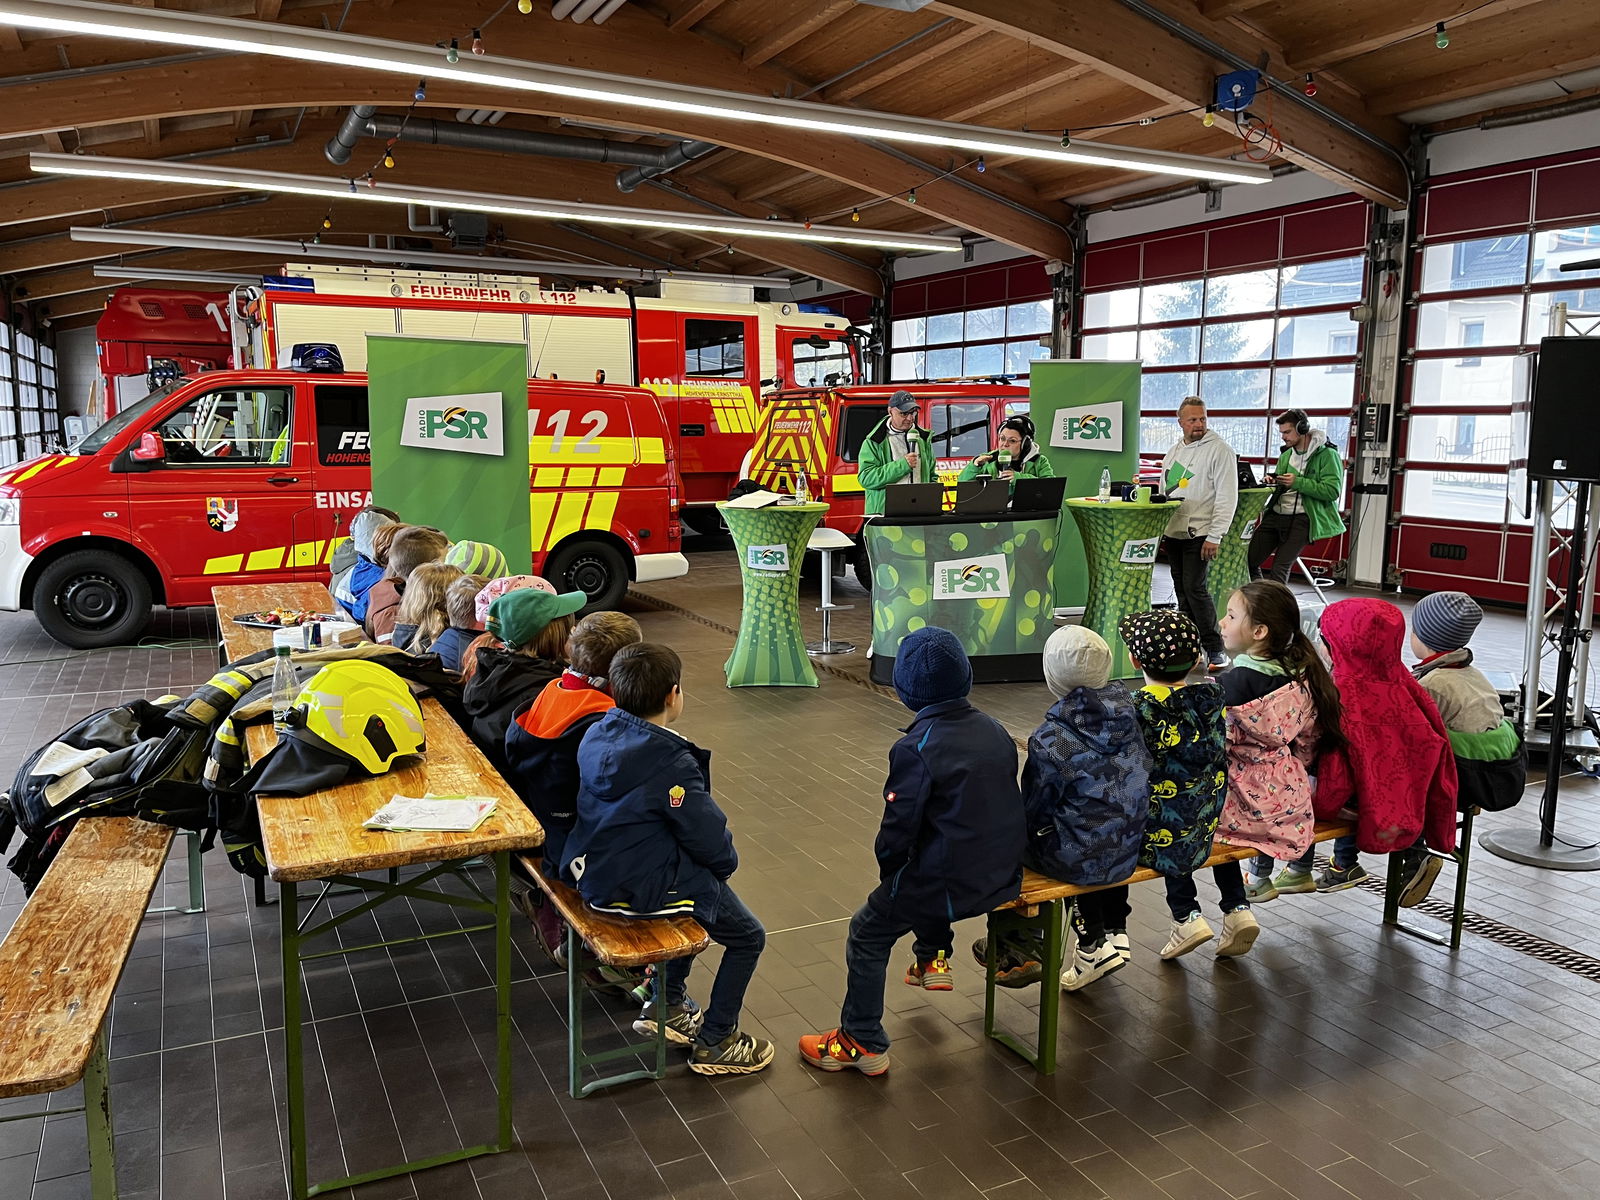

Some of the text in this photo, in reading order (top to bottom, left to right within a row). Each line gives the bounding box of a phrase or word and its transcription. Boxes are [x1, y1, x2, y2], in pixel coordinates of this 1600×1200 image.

[410, 285, 577, 304] FEUERWEHR 112
[680, 380, 741, 391] FEUERWEHR
[418, 406, 488, 439] RADIO PSR
[798, 421, 811, 433] 112
[1068, 414, 1112, 440] PSR
[338, 431, 371, 450] FE
[754, 549, 785, 565] PSR
[1130, 542, 1156, 558] PSR
[948, 564, 1000, 593] PSR
